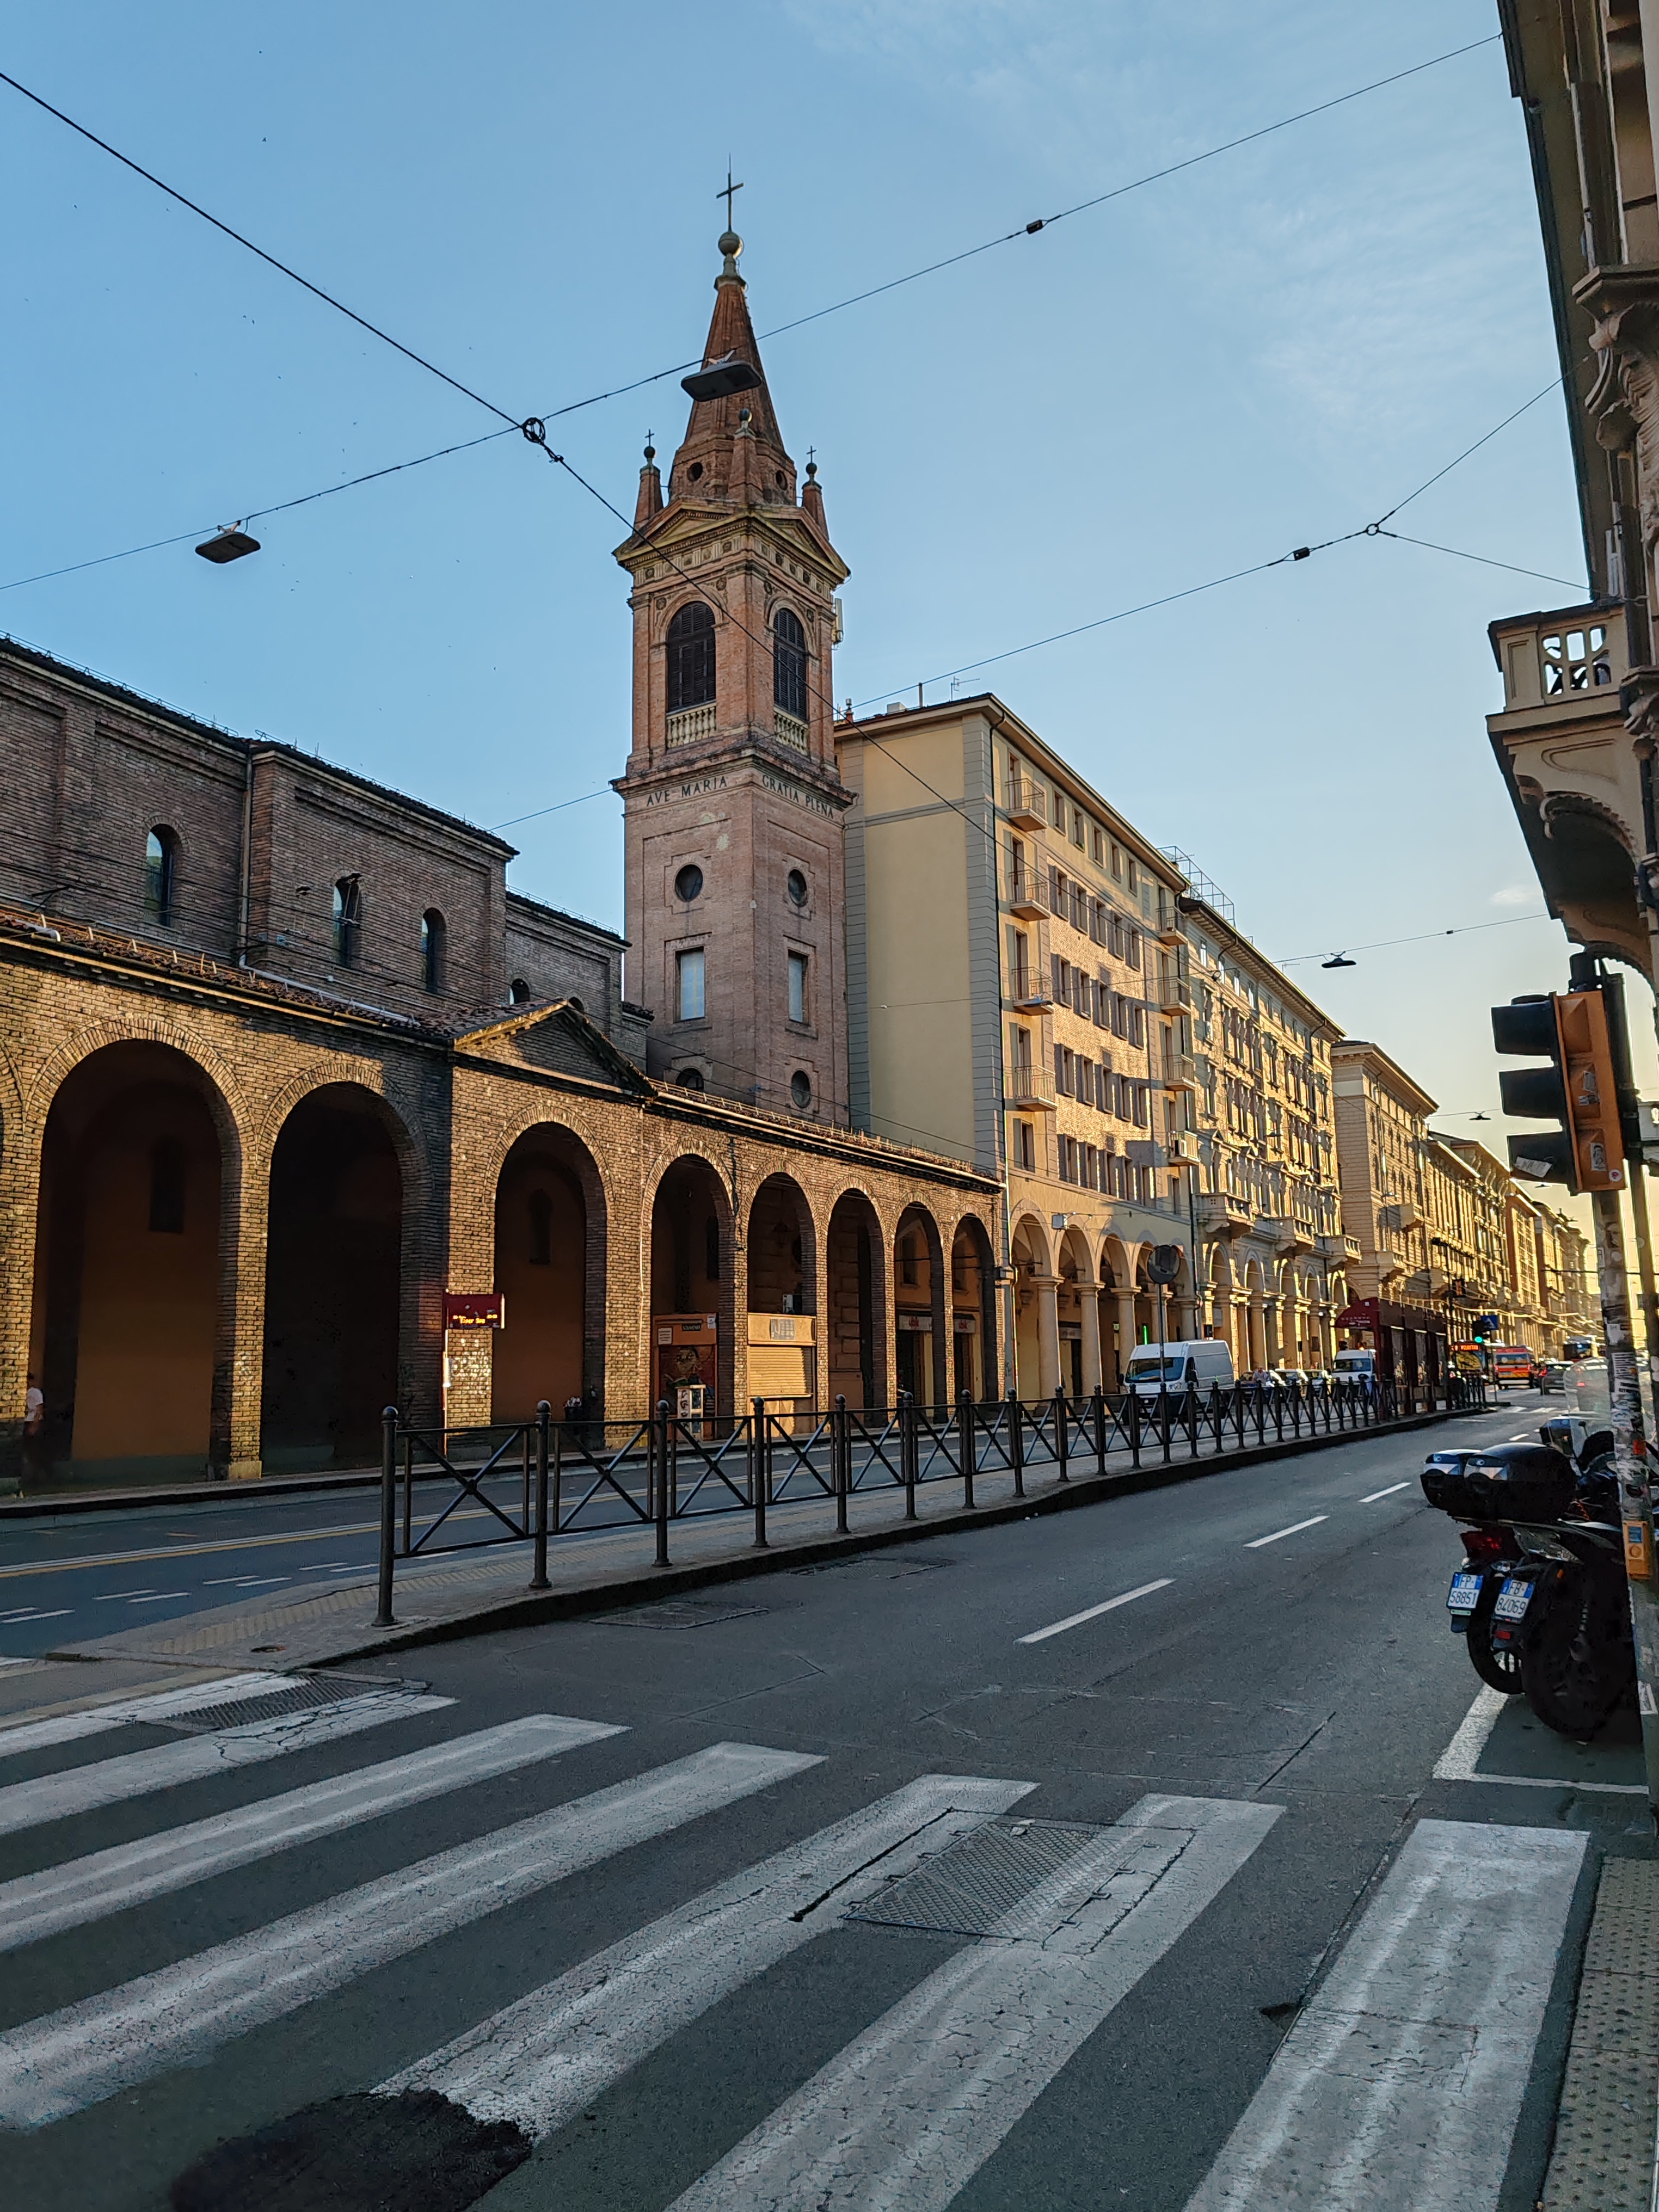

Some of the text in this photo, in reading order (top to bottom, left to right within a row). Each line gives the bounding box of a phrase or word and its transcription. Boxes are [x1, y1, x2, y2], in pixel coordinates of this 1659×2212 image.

[646, 775, 727, 807] AVE MARIA
[762, 774, 833, 820] GRATIA PLENA
[1460, 1575, 1472, 1588] FP
[1449, 1590, 1477, 1605] 58851
[1496, 1597, 1526, 1615] 84069
